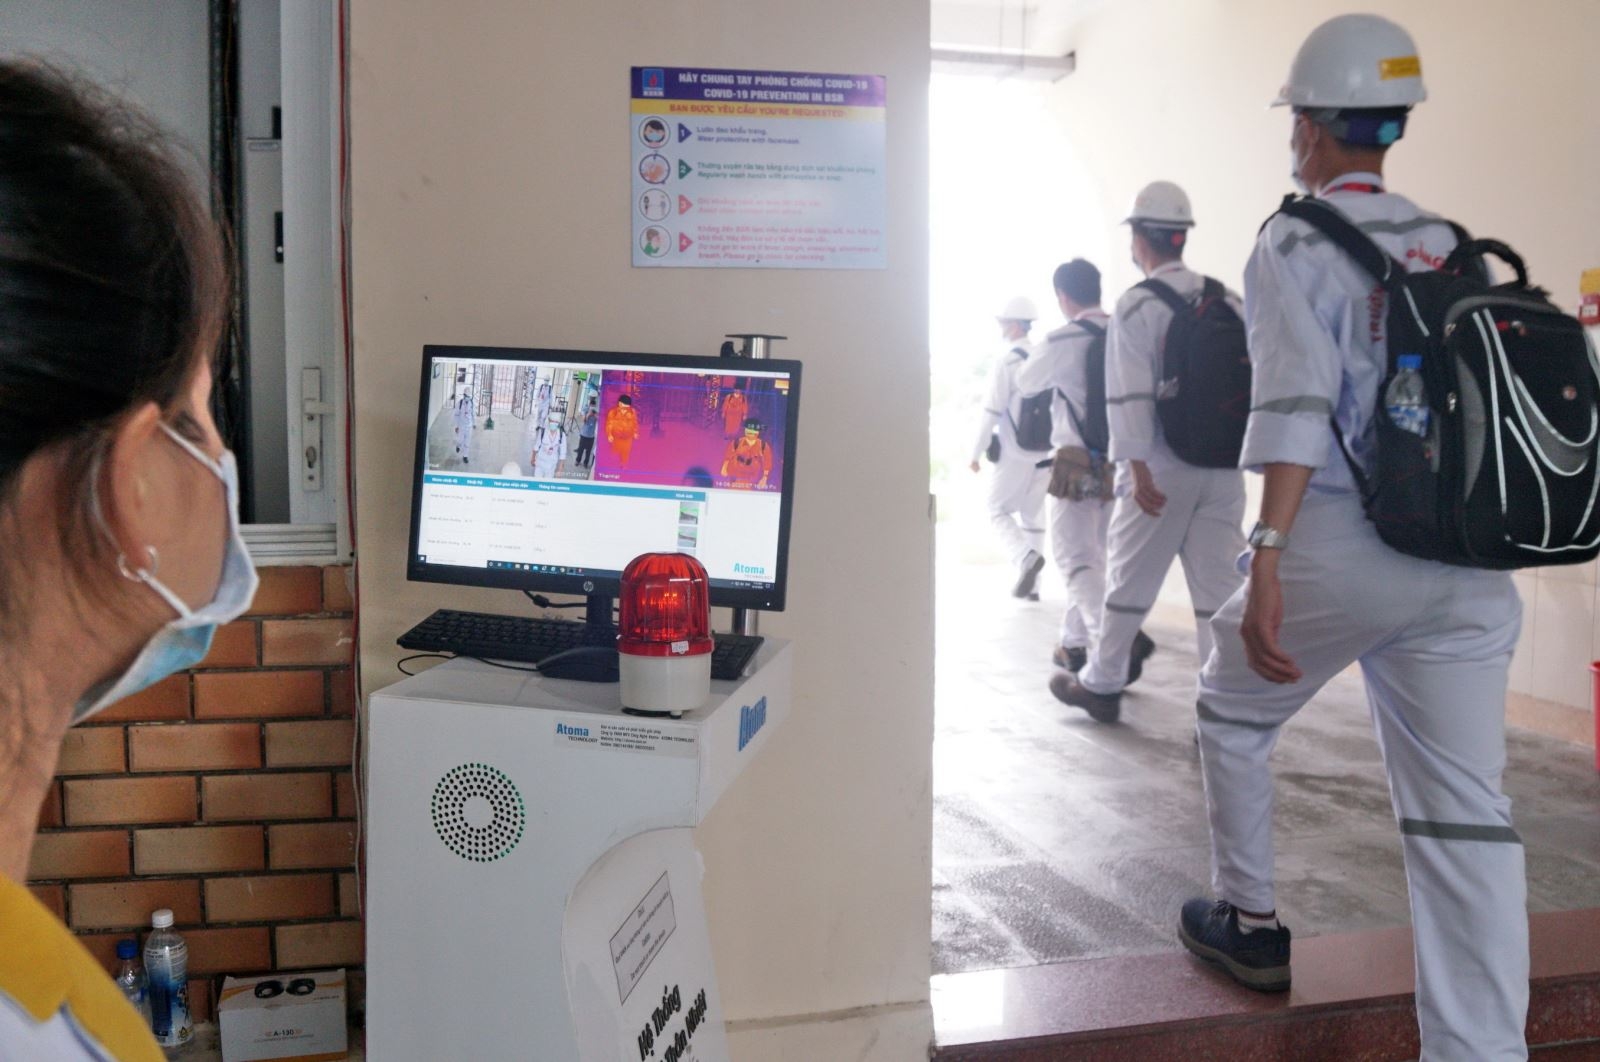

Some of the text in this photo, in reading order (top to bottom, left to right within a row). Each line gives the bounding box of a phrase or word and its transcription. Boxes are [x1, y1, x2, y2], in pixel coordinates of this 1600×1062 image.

[679, 72, 868, 90] HÃY CHUNG TAY PHÒNG CHỐNG COVID-19
[704, 88, 844, 103] COVID-19 PREVENTION IN BSR
[733, 562, 765, 575] Atoma
[556, 723, 589, 737] Atoma
[651, 984, 682, 1038] Thống
[685, 988, 708, 1040] Nhiệt
